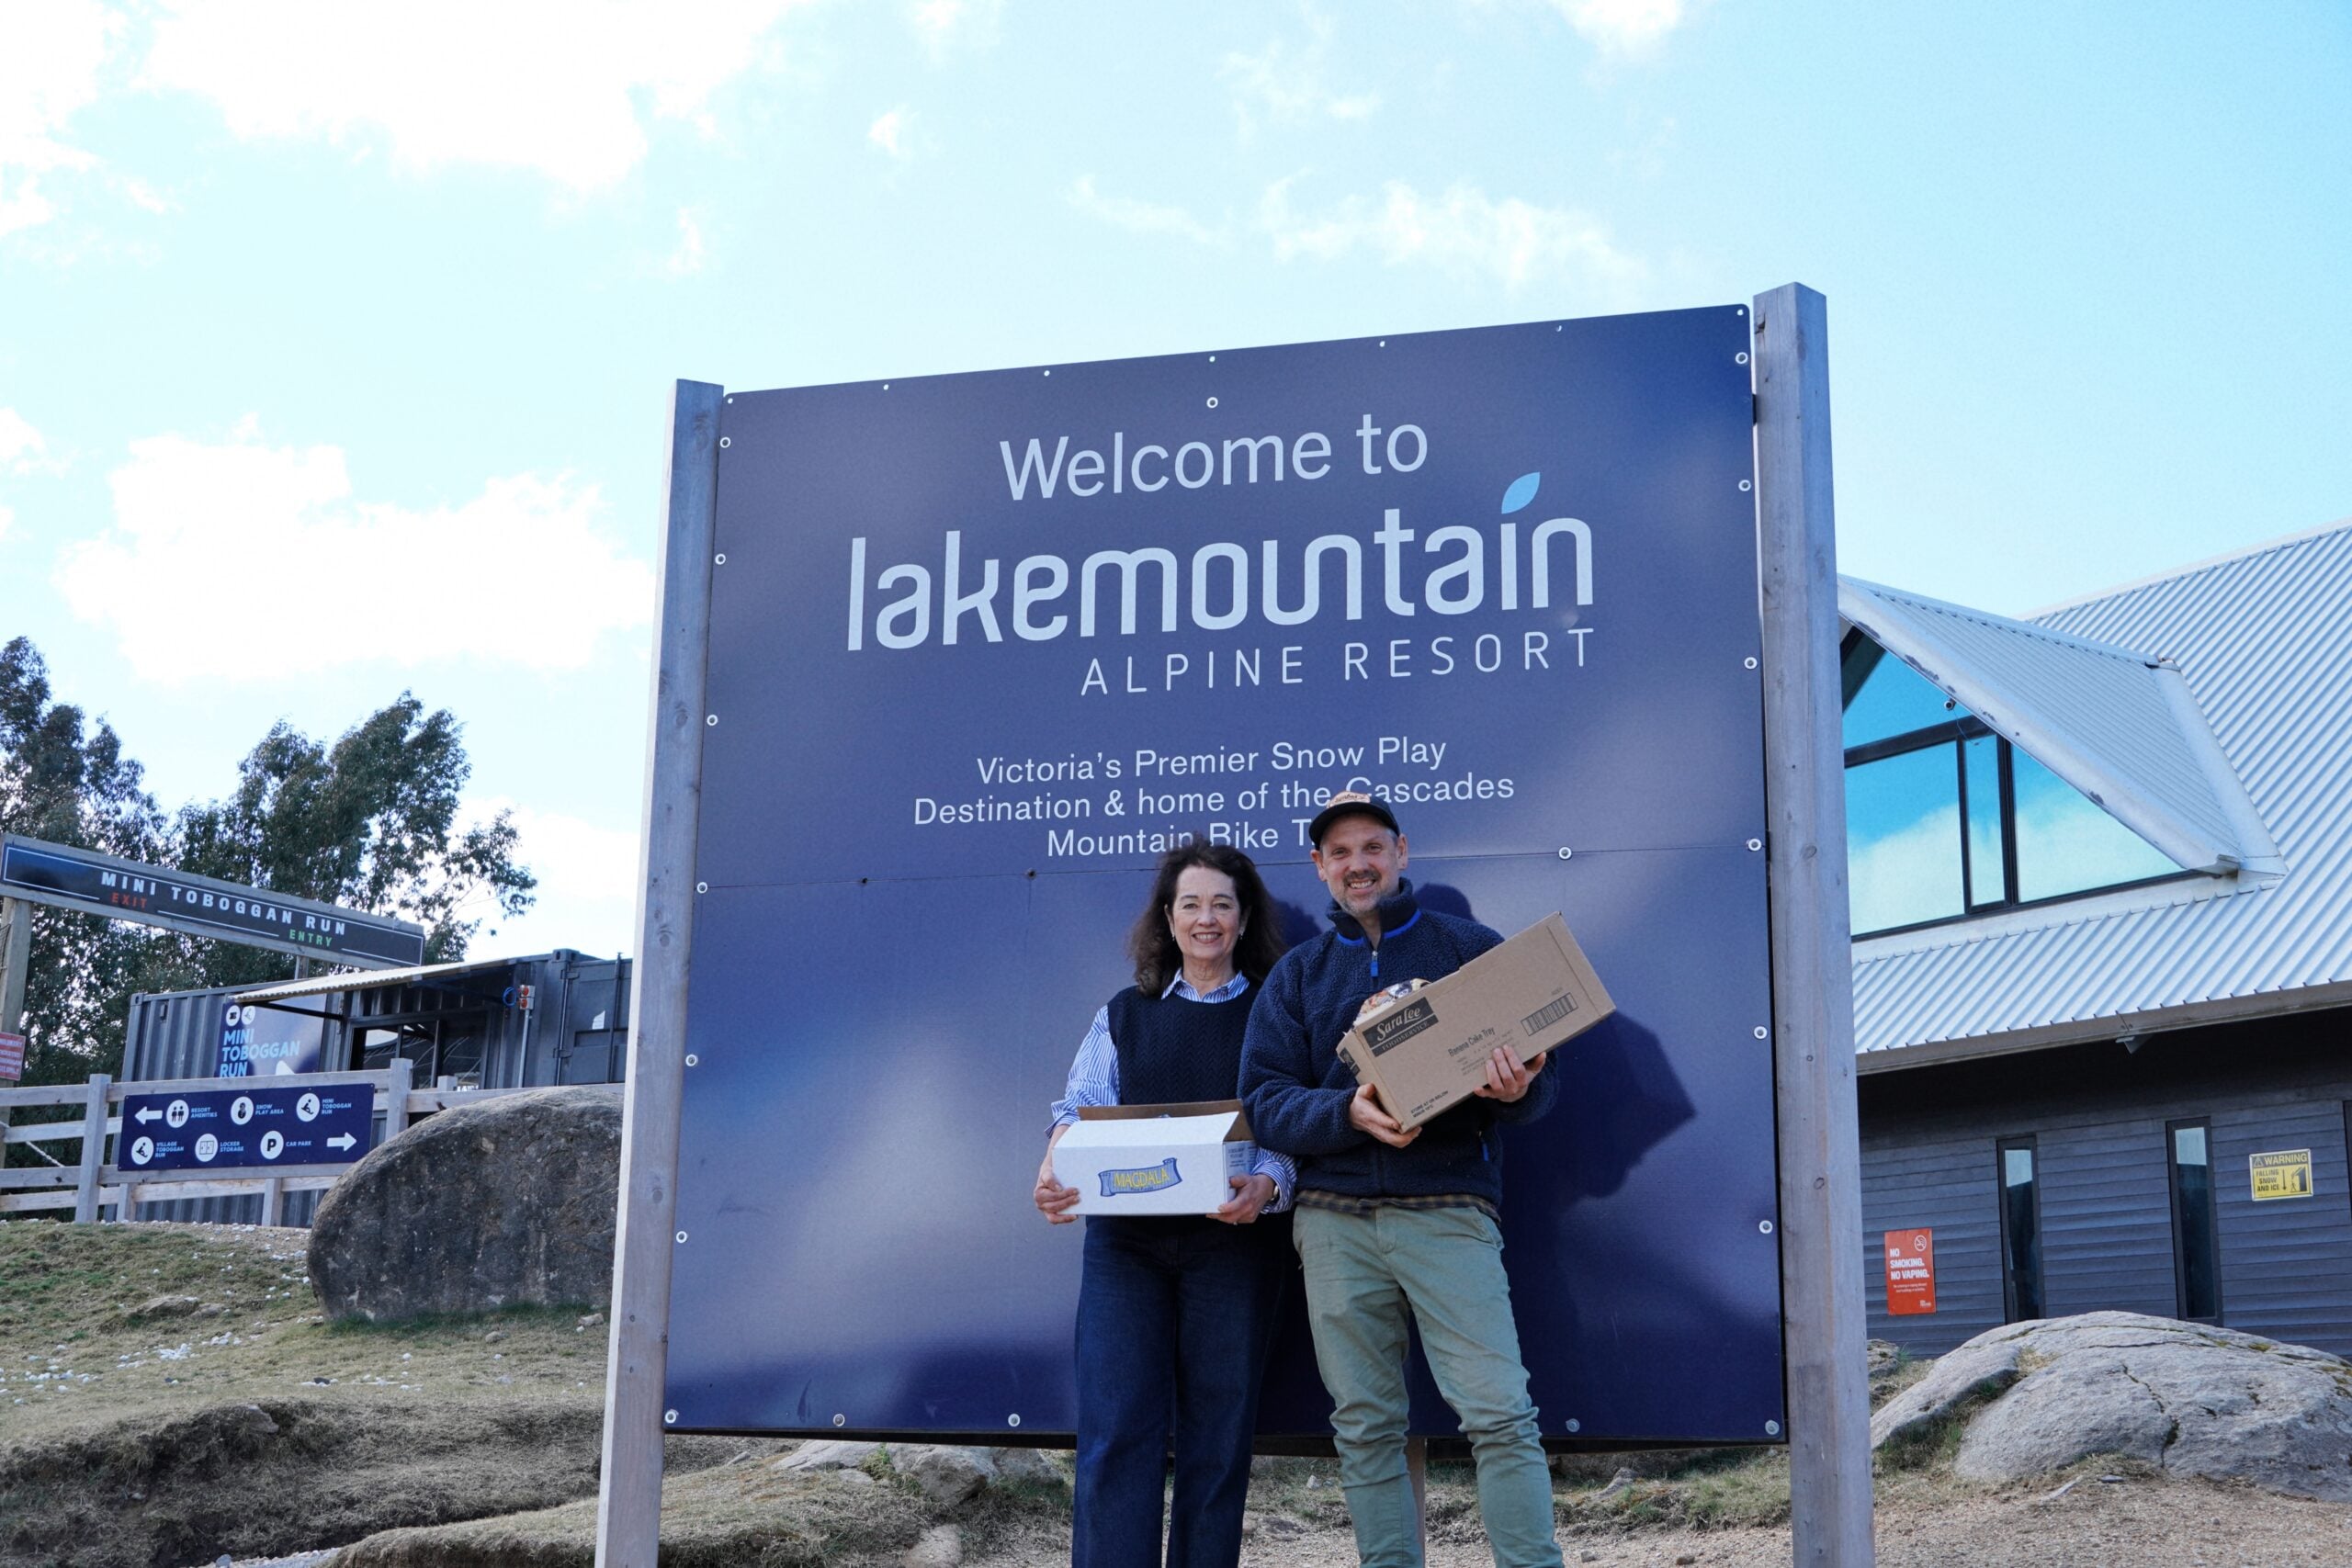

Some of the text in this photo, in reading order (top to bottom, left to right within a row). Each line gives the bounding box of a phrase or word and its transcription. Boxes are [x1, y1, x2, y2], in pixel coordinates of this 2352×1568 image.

[1000, 414, 1427, 501] Welcome to
[848, 507, 1593, 650] lakemountain
[1081, 628, 1594, 695] ALPINE RESORT
[978, 737, 1447, 784] Victoria's Premier Snow Play
[915, 793, 1091, 825] Destination
[1104, 789, 1125, 817] &
[1139, 788, 1225, 815] home
[1238, 783, 1269, 810] of
[1281, 781, 1331, 808] the
[1210, 821, 1279, 849] Bike
[101, 872, 346, 935] MINI TOBOGGAN RUN
[111, 893, 148, 909] EXIT
[288, 929, 334, 947] ENTRY
[1376, 1007, 1422, 1042] Sara Lee
[1382, 1021, 1429, 1051] FOODSERVICE
[223, 1029, 254, 1045] MINI
[1448, 1042, 1469, 1057] Banana
[1468, 1033, 1483, 1045] Cake
[1481, 1027, 1495, 1037] Tray
[222, 1041, 300, 1062] TOBOGGAN
[220, 1062, 248, 1077] RUN
[2264, 1153, 2307, 1166] WARNING
[1114, 1168, 1169, 1187] MAGDALA
[1890, 1248, 1900, 1258] NO
[1890, 1258, 1925, 1269] SMOKING.
[1891, 1269, 1929, 1280] NO VAPING.
